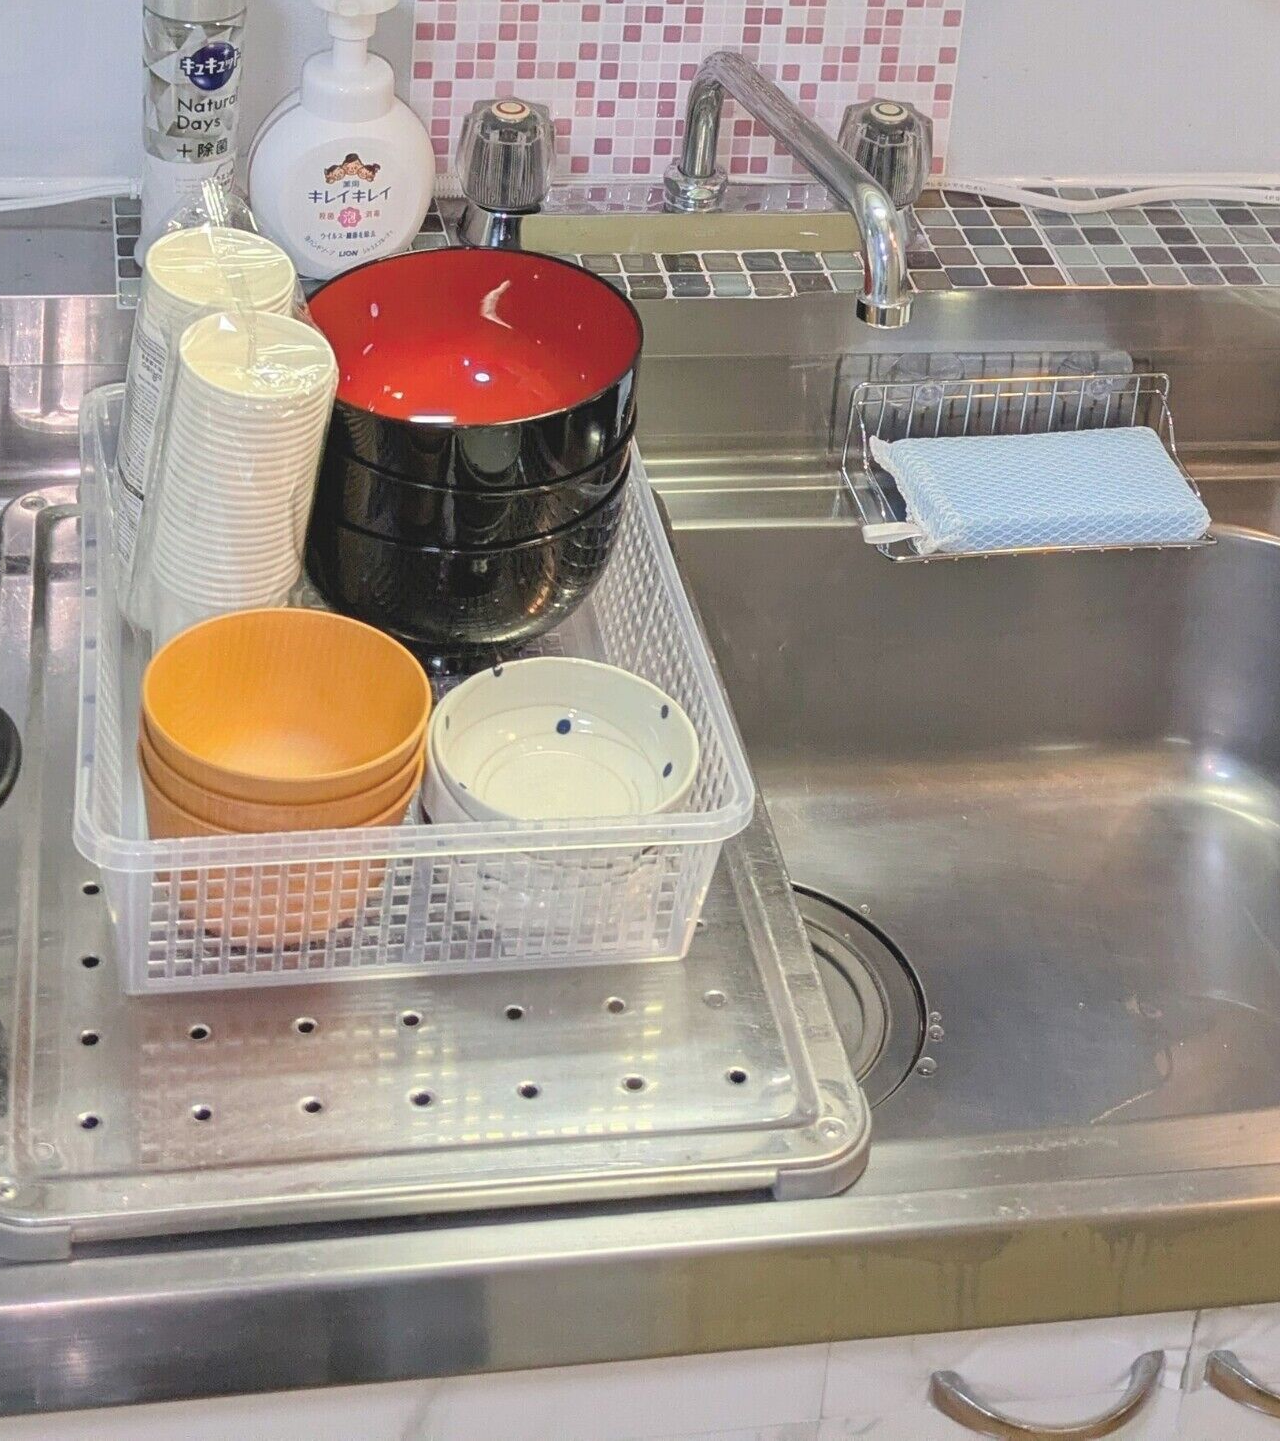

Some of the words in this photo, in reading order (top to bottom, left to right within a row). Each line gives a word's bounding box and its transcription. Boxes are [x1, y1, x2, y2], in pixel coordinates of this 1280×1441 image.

[176, 114, 221, 132] Days
[308, 186, 392, 204] キレイキレイ
[338, 249, 359, 258] LION
